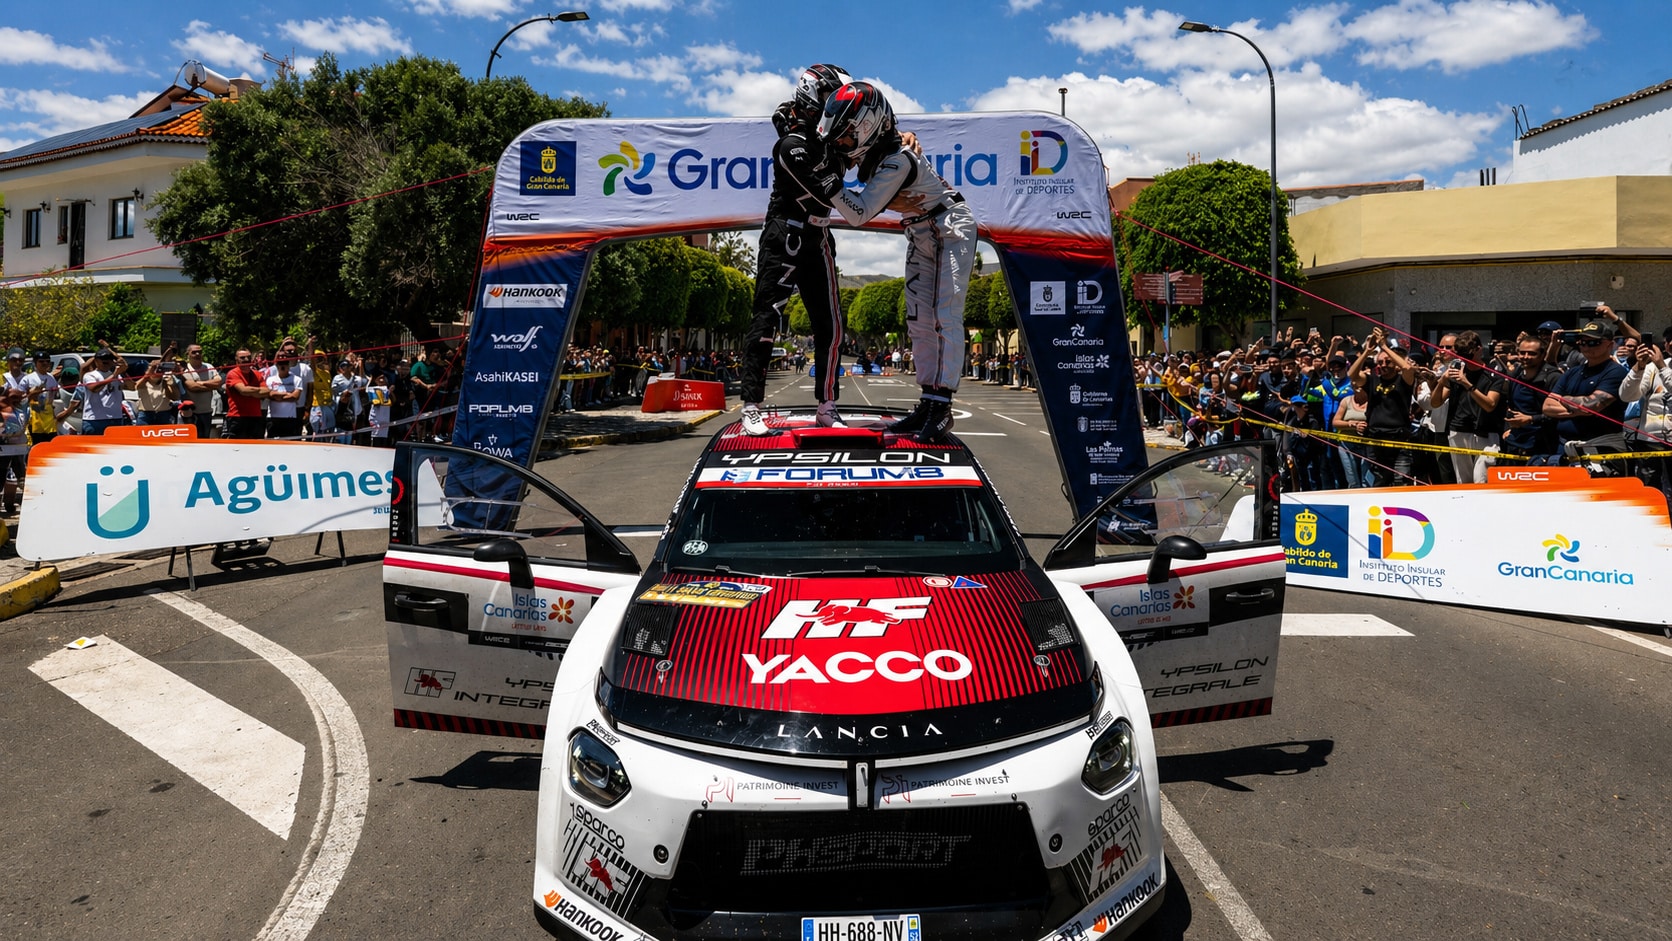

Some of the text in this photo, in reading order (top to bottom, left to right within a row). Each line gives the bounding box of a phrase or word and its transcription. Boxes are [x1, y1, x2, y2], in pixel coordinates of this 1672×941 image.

[1027, 185, 1076, 195] DEPORTES
[506, 213, 540, 221] WRC
[1057, 210, 1092, 219] WRC
[475, 371, 539, 383] AsahiKASEI
[141, 428, 190, 438] WRC
[721, 451, 951, 464] YPSILON
[756, 466, 945, 481] FORUM8
[1497, 471, 1550, 481] WRC
[1284, 546, 1332, 559] abildo de
[1298, 558, 1339, 570] Canaria
[1377, 572, 1443, 588] DEPORTES
[1497, 562, 1634, 586] GranCanaria
[515, 593, 547, 608] Islas
[1140, 588, 1171, 603] Islas
[484, 603, 547, 622] Canarias
[1110, 601, 1172, 618] Canarias
[741, 649, 973, 684] YACCO
[1161, 656, 1269, 679] YPSILON
[1143, 675, 1262, 699] TEGRALE
[454, 691, 552, 710] INTEG
[776, 722, 943, 740] LANCIA
[736, 781, 801, 790] PATRIMOINE
[802, 780, 839, 790] INVEST
[910, 777, 974, 789] PATRIMOINE
[974, 775, 1010, 786] INVEST
[1087, 793, 1129, 837] sparco
[575, 803, 625, 852] sparco
[818, 920, 904, 941] HH-688-NV
